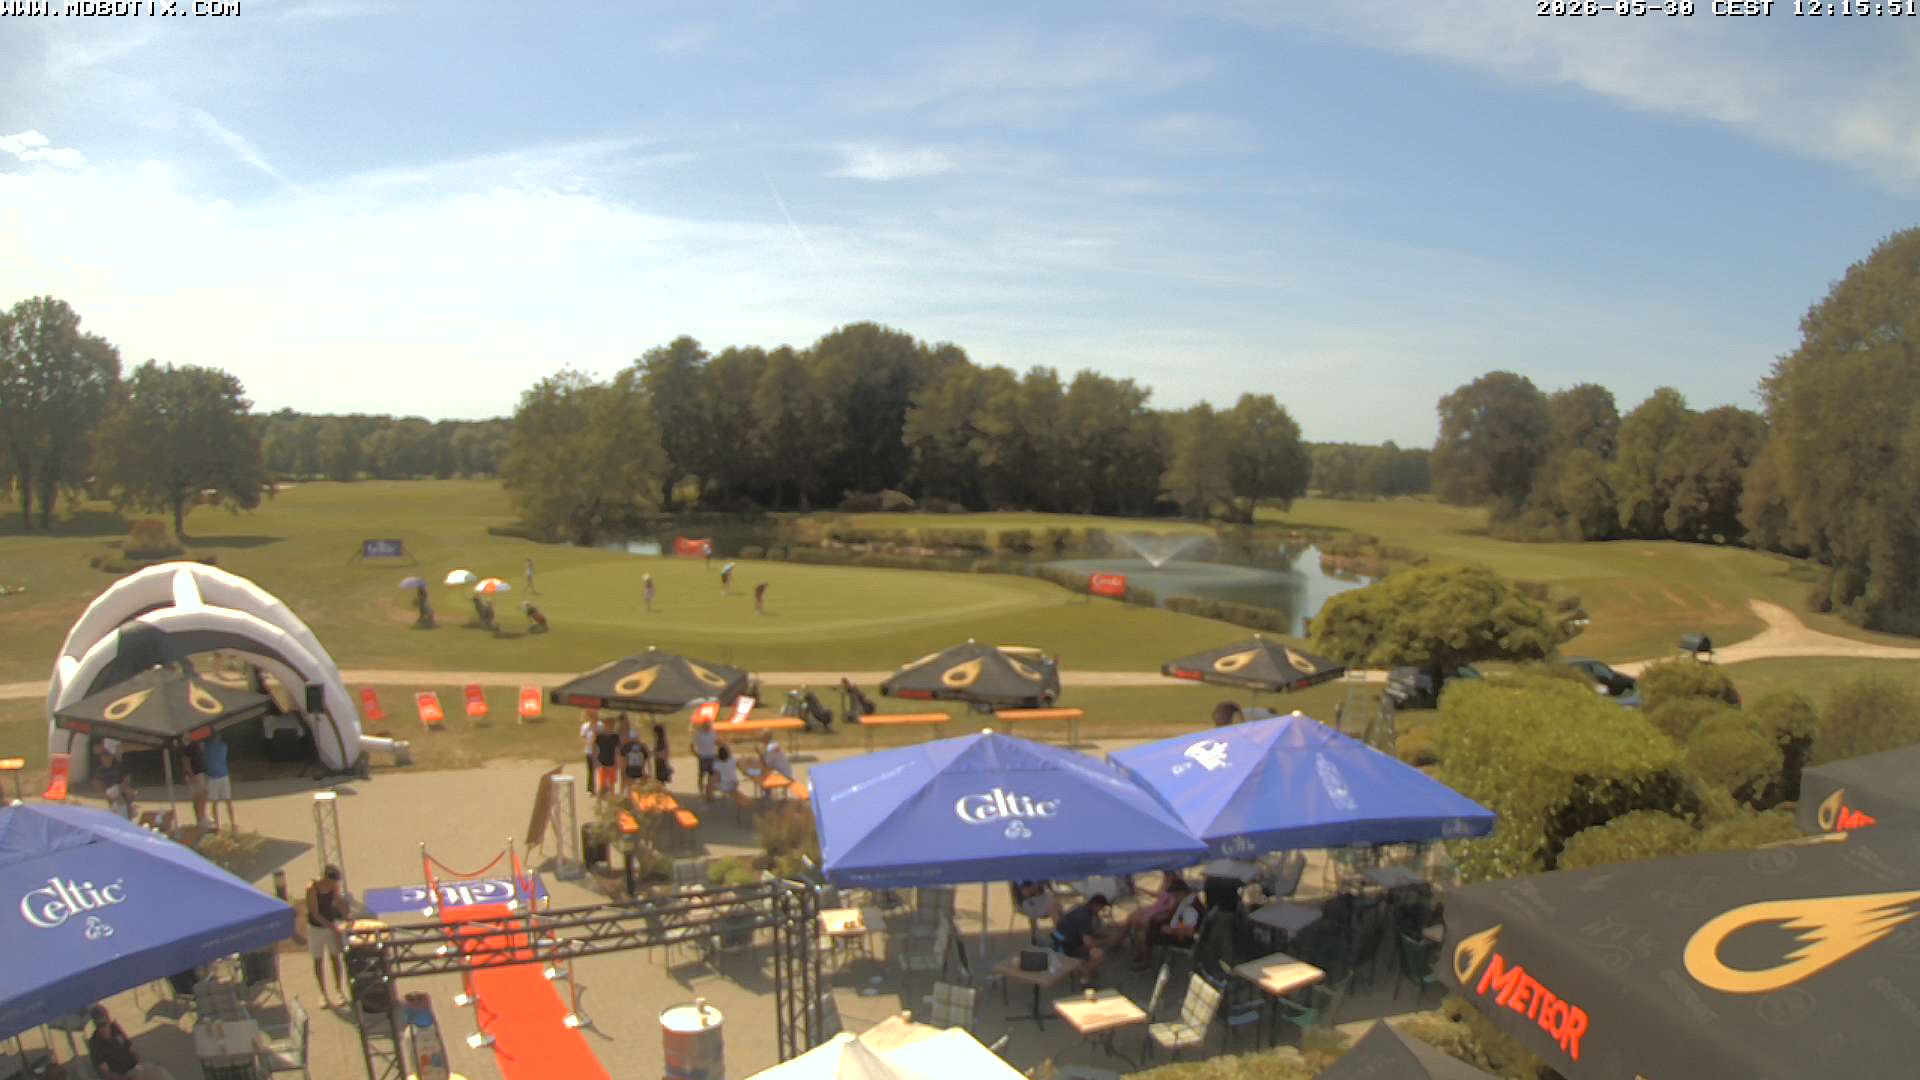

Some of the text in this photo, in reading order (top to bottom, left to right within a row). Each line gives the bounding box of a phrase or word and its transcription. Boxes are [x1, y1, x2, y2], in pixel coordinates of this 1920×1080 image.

[955, 786, 1059, 824] Celtic
[20, 876, 127, 928] Celtic
[1476, 952, 1590, 1062] METEOR
